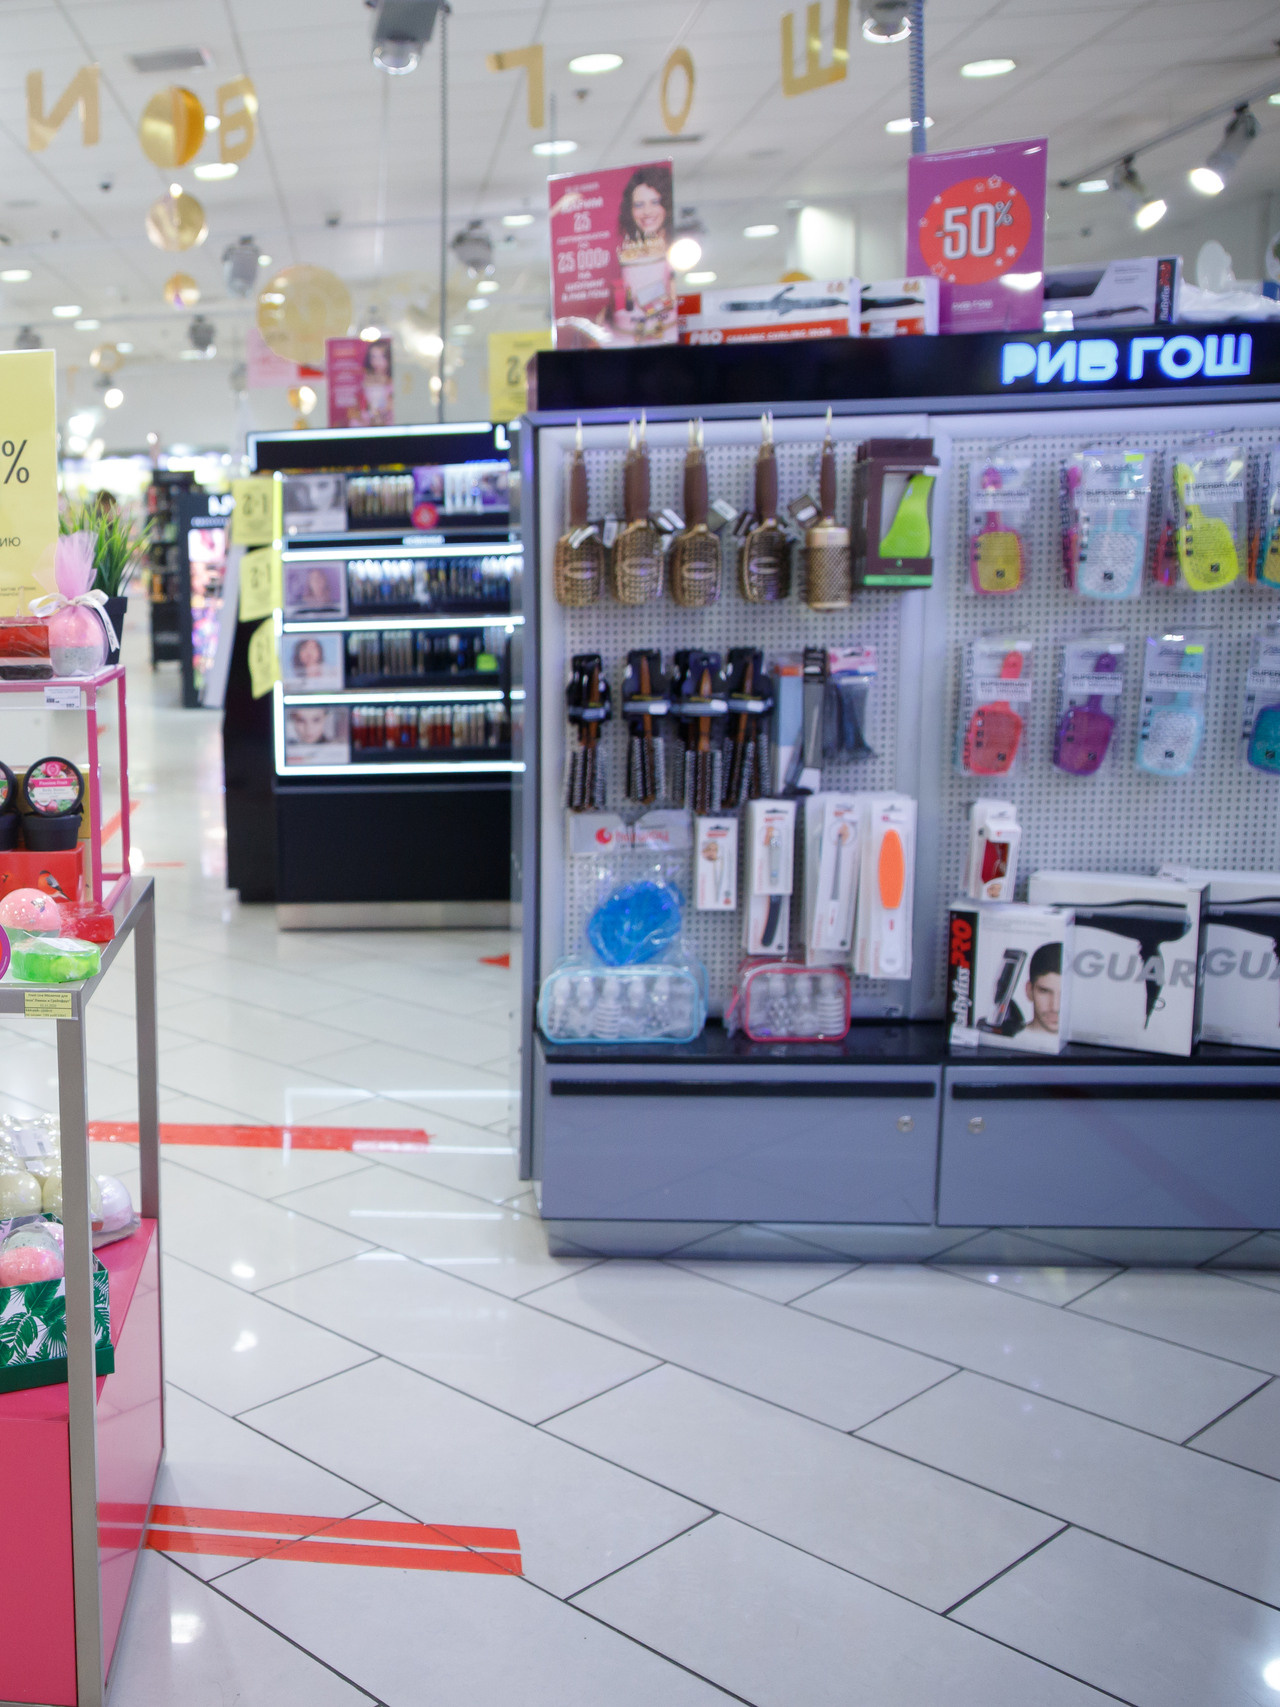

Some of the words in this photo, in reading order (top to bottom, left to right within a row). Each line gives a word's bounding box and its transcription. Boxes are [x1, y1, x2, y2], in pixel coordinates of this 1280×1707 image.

[935, 200, 1014, 260] -50%
[1002, 338, 1119, 385] РИВ
[1128, 334, 1253, 380] ГОШ
